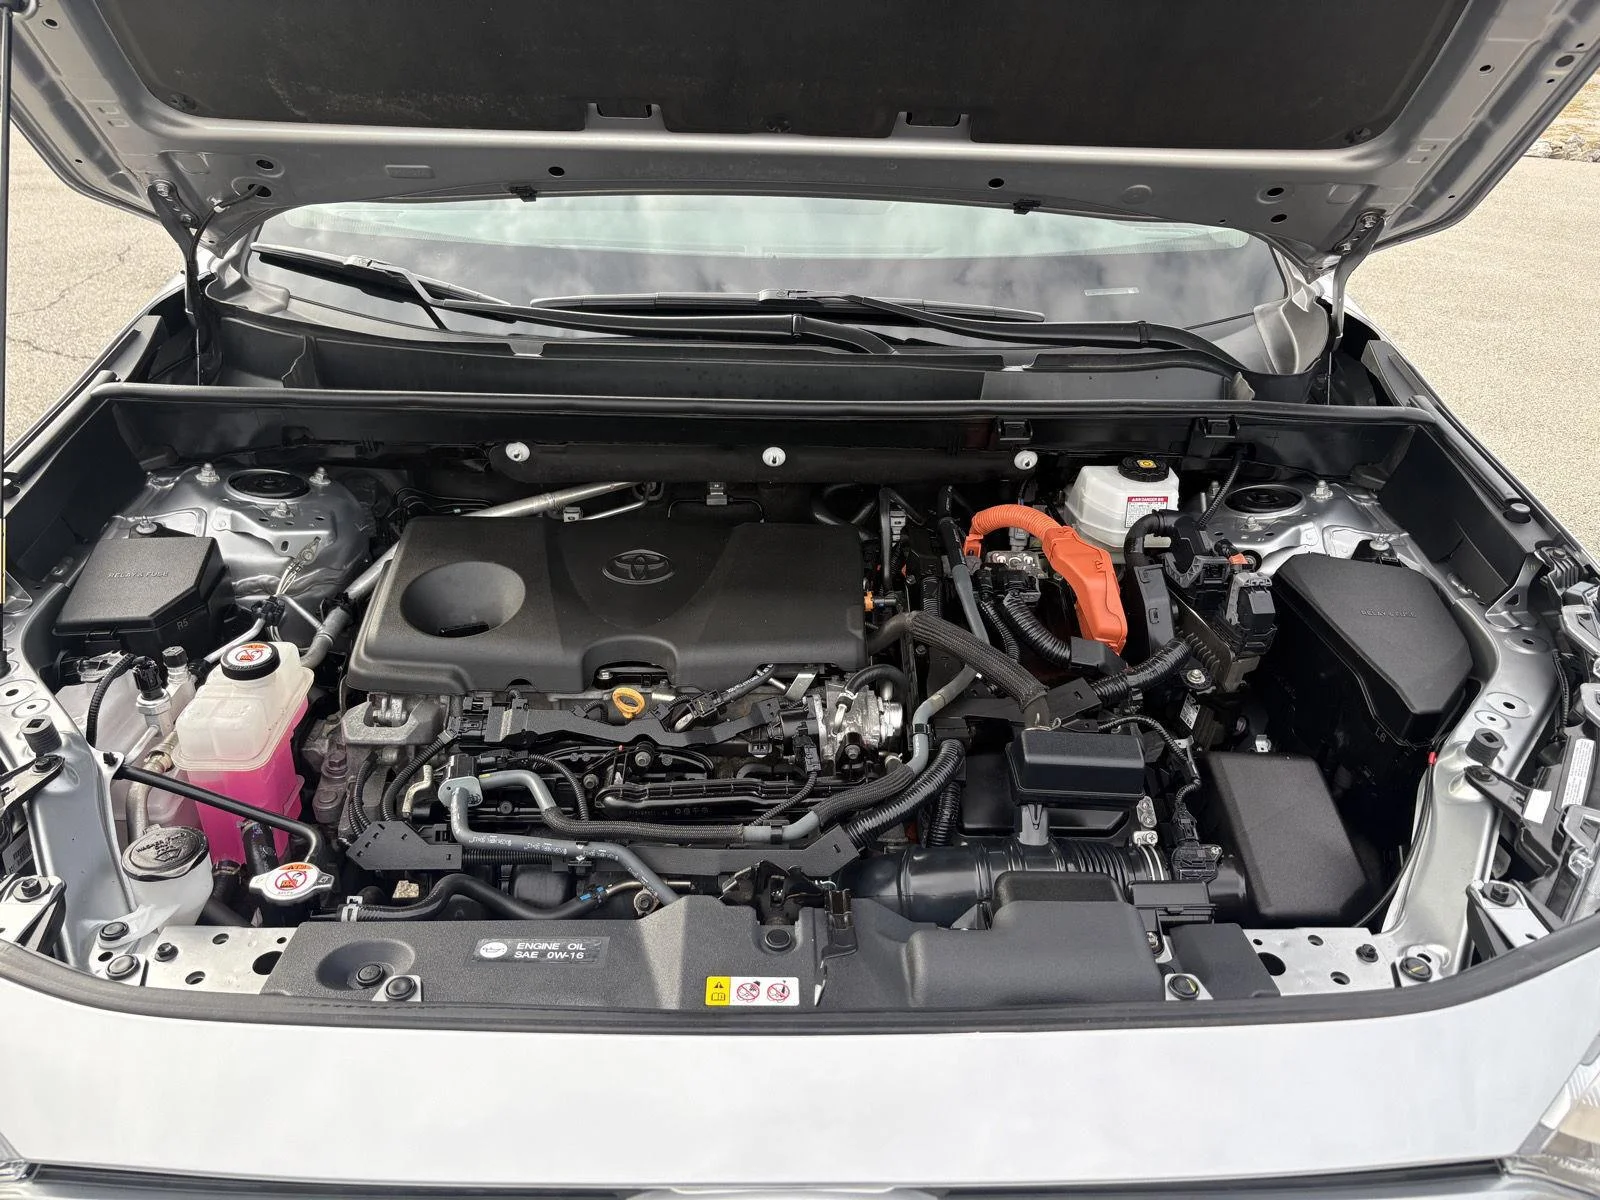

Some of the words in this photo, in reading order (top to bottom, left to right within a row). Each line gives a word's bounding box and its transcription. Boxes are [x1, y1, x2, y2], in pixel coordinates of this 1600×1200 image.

[516, 942, 561, 951] ENGINE
[567, 942, 587, 951] OIL
[514, 951, 539, 959] SAE
[547, 951, 585, 959] 0W-16
